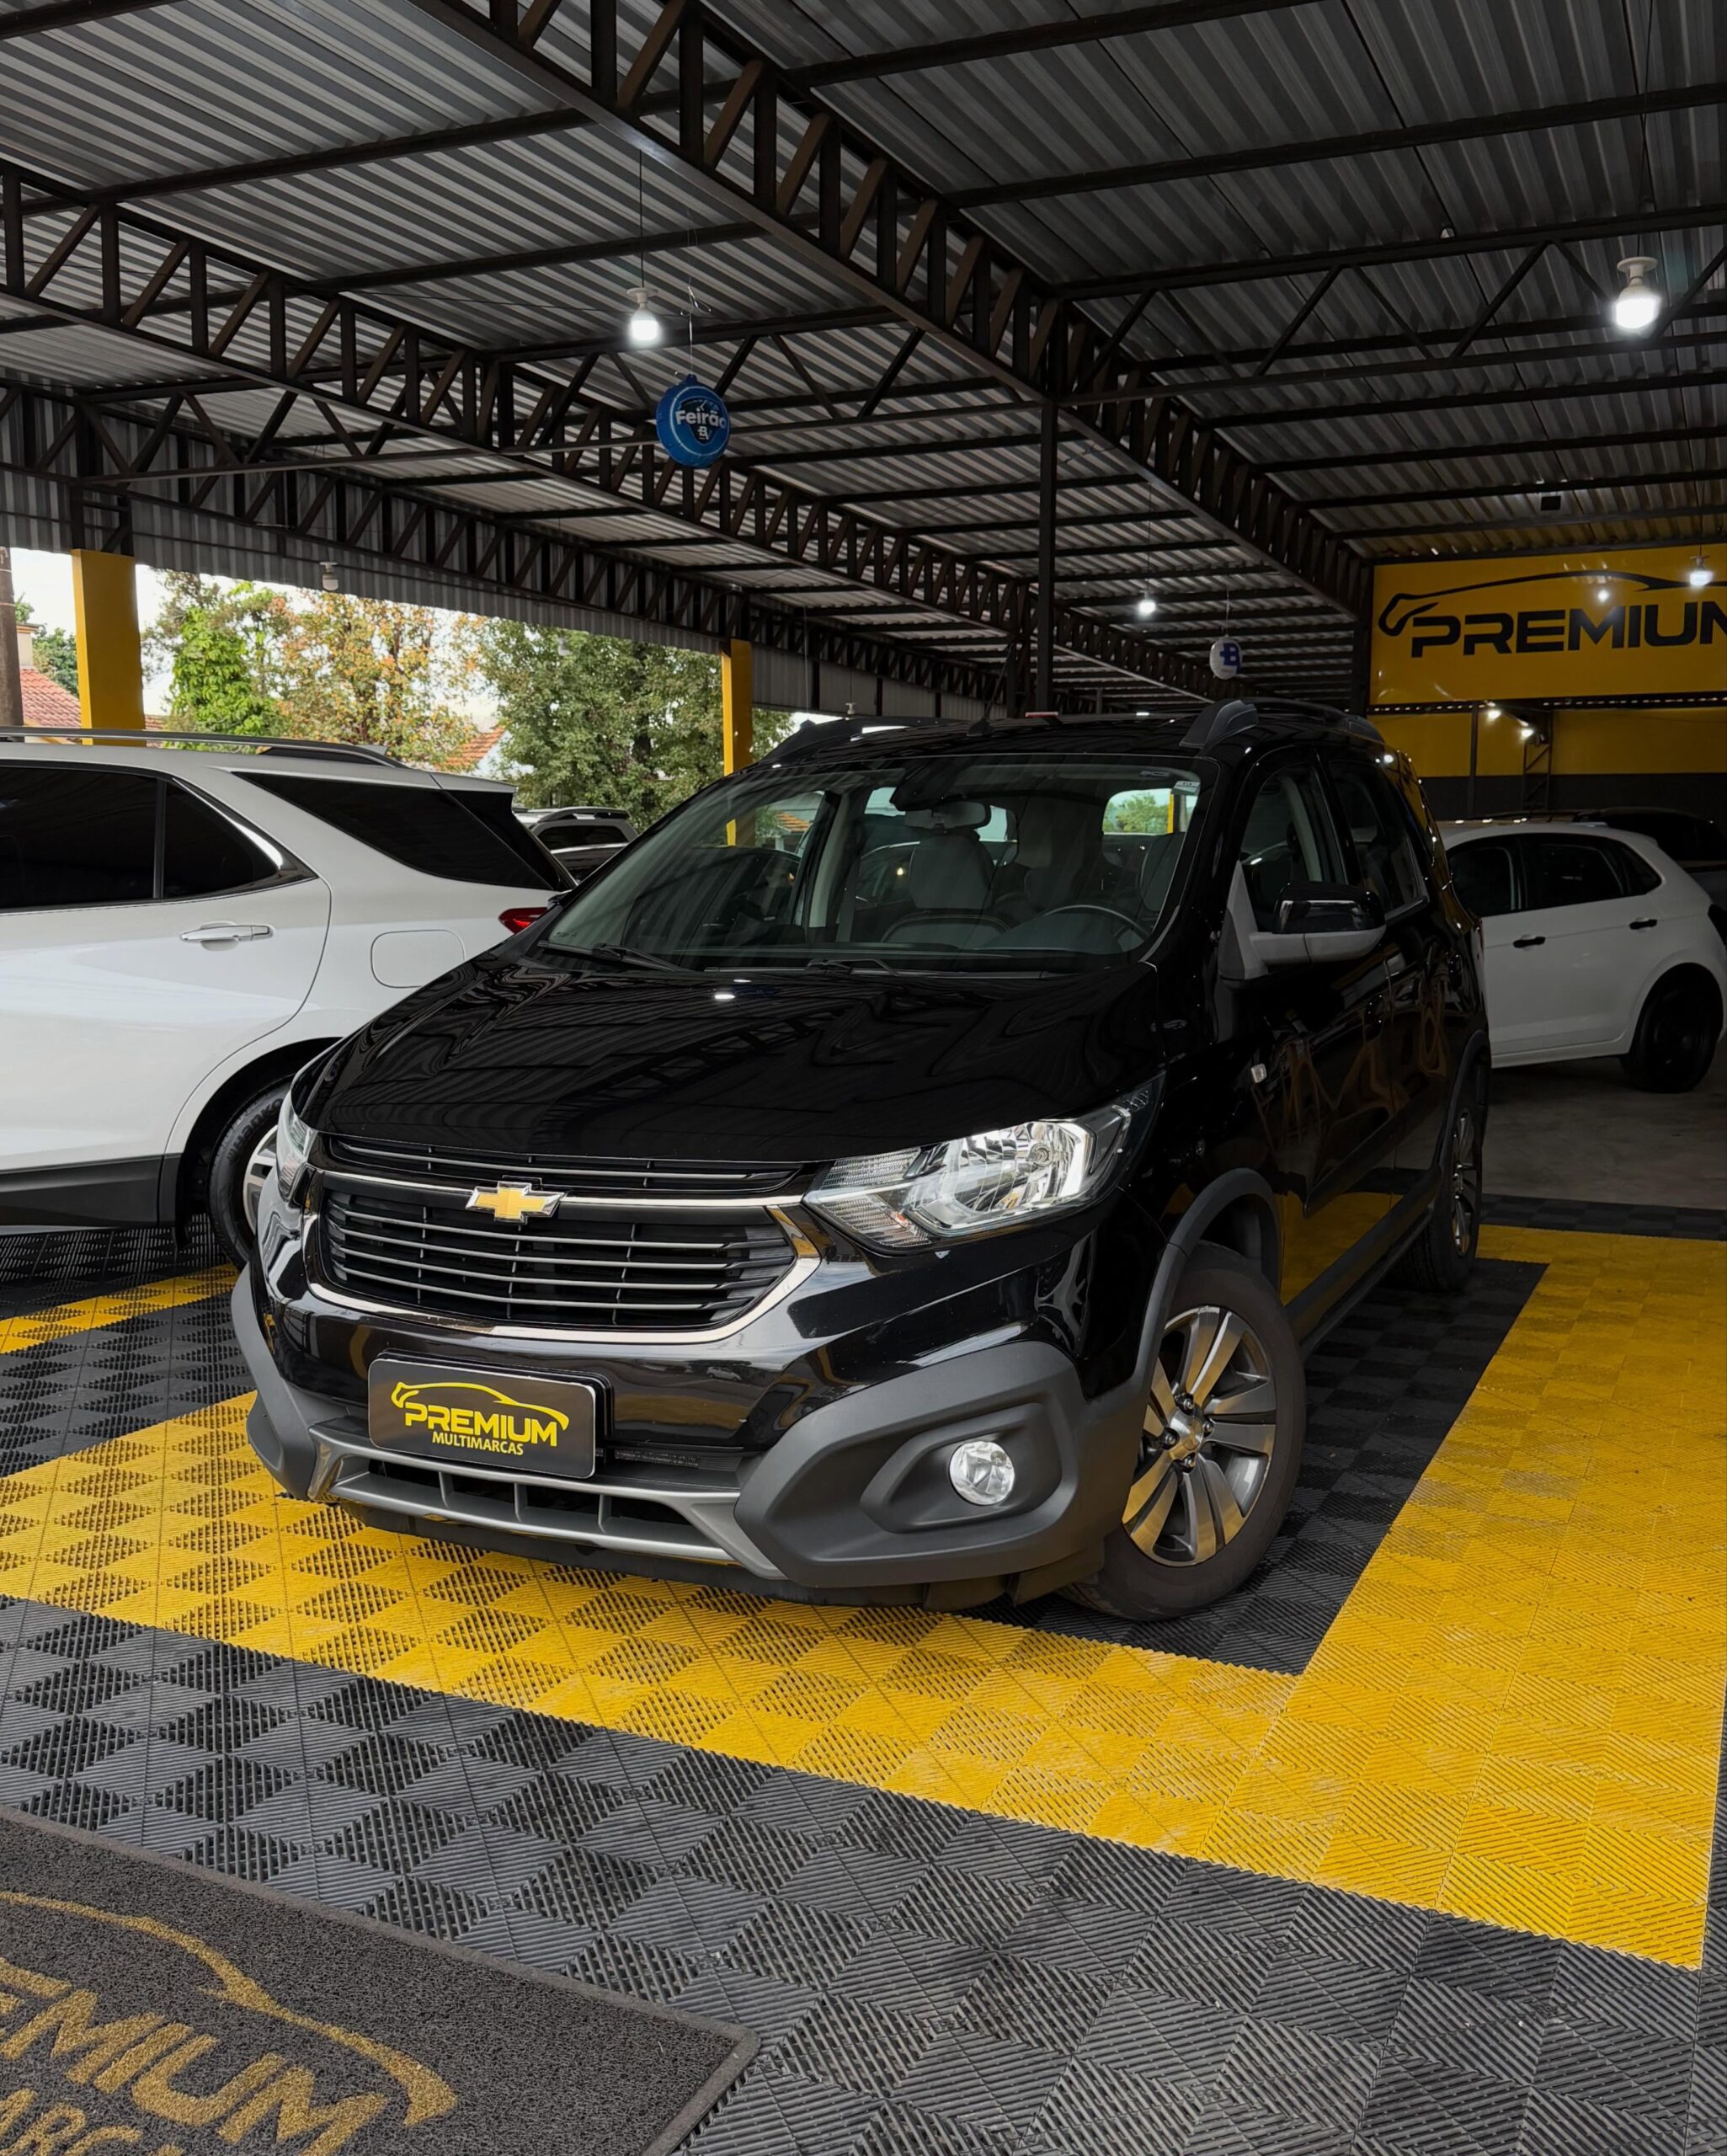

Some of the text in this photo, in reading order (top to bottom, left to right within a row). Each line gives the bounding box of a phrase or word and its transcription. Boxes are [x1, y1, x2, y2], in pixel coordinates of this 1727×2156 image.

[675, 408, 727, 429] Feirão
[403, 1402, 557, 1447] PREMIUM
[432, 1432, 524, 1455] MULTIMARCAS
